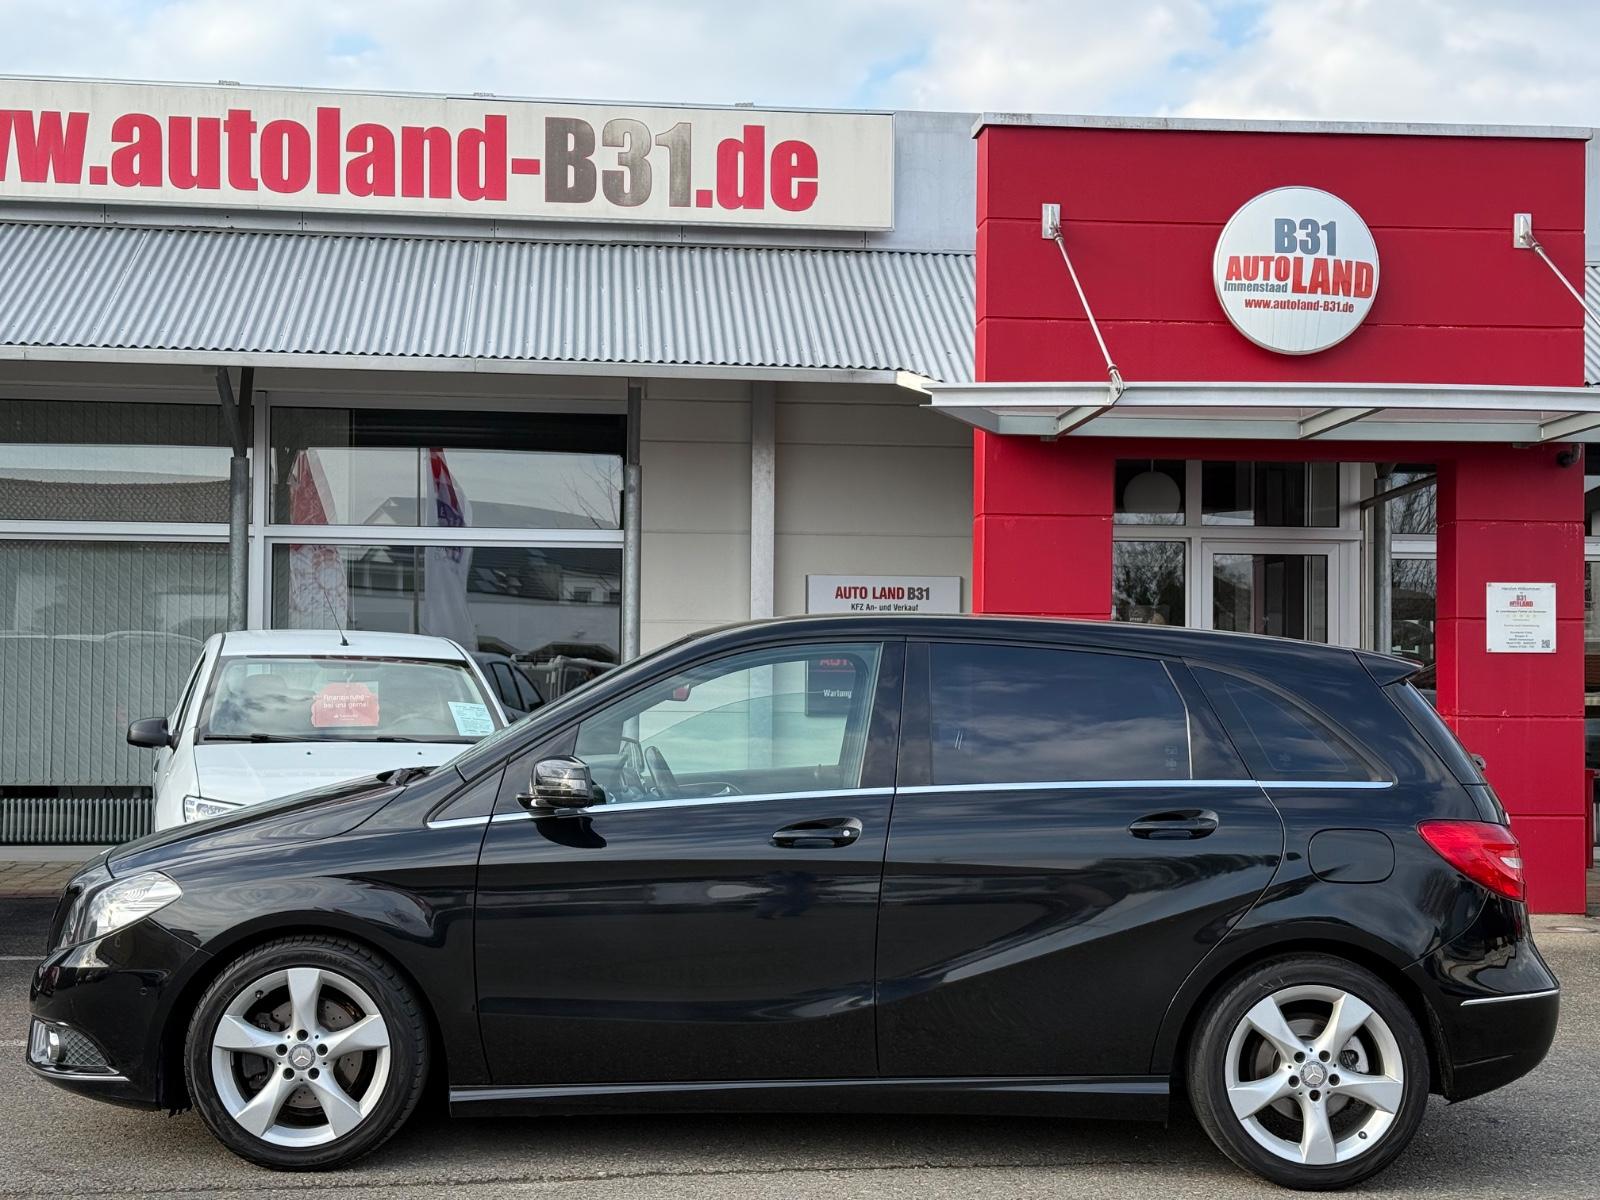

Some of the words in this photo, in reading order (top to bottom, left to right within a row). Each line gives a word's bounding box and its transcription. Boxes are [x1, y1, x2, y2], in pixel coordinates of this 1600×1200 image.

[1275, 218, 1336, 256] B31
[1224, 281, 1288, 293] Immenstaad
[1244, 298, 1355, 313] www.autoland-B31.de
[835, 586, 868, 599] AUTO
[872, 587, 905, 600] LAND
[907, 587, 930, 600] B31
[851, 603, 864, 611] KFZ
[866, 603, 877, 611] An-
[879, 603, 892, 611] und
[893, 604, 919, 612] Verkauf
